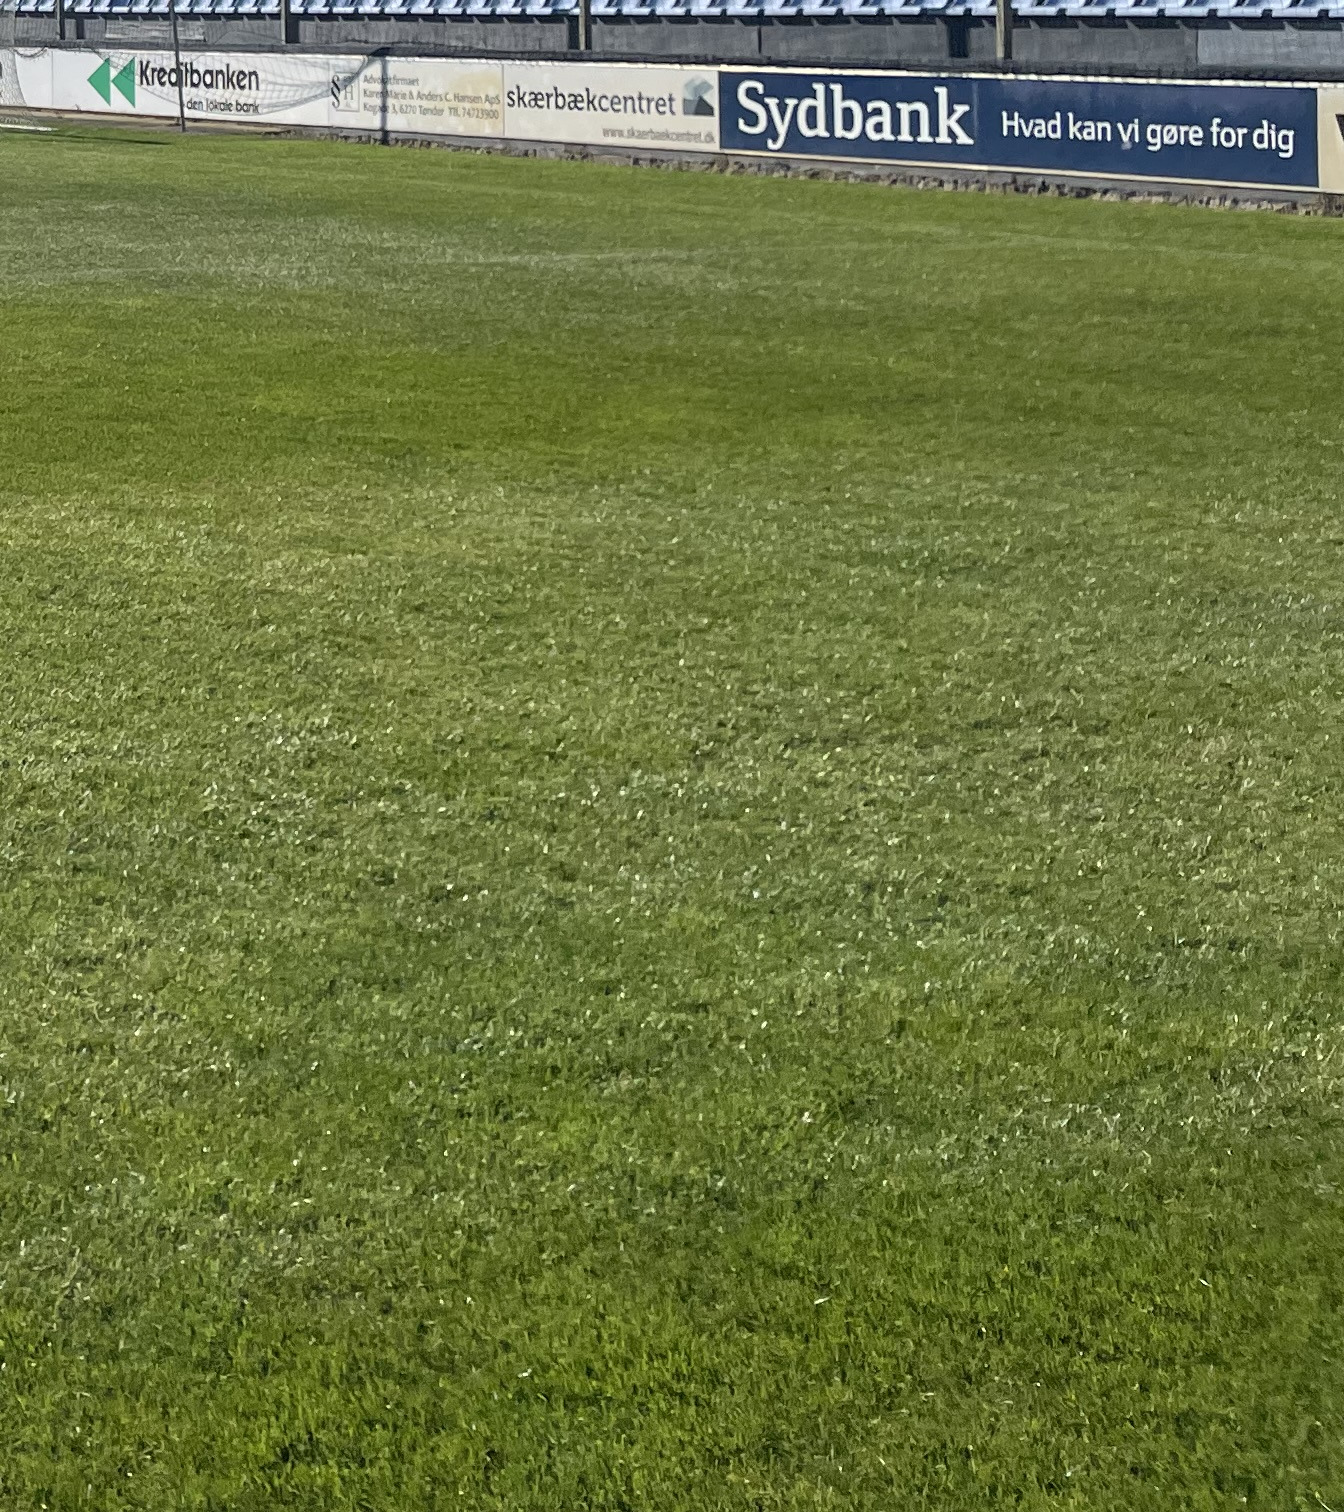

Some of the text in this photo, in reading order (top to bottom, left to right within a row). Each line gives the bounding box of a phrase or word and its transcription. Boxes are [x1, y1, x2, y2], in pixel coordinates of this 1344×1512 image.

[139, 59, 260, 91] Kreditbanken
[205, 98, 234, 113] lokale
[235, 99, 260, 114] bank
[399, 104, 417, 115] 6270
[418, 105, 445, 116] Tønder
[416, 91, 444, 102] Anders
[453, 93, 483, 105] Hansen
[484, 94, 501, 108] ApS
[506, 84, 677, 116] skærbækcentret
[736, 79, 975, 151] Sydbank
[1001, 110, 1296, 159] Hvad kan vi gøre for dig
